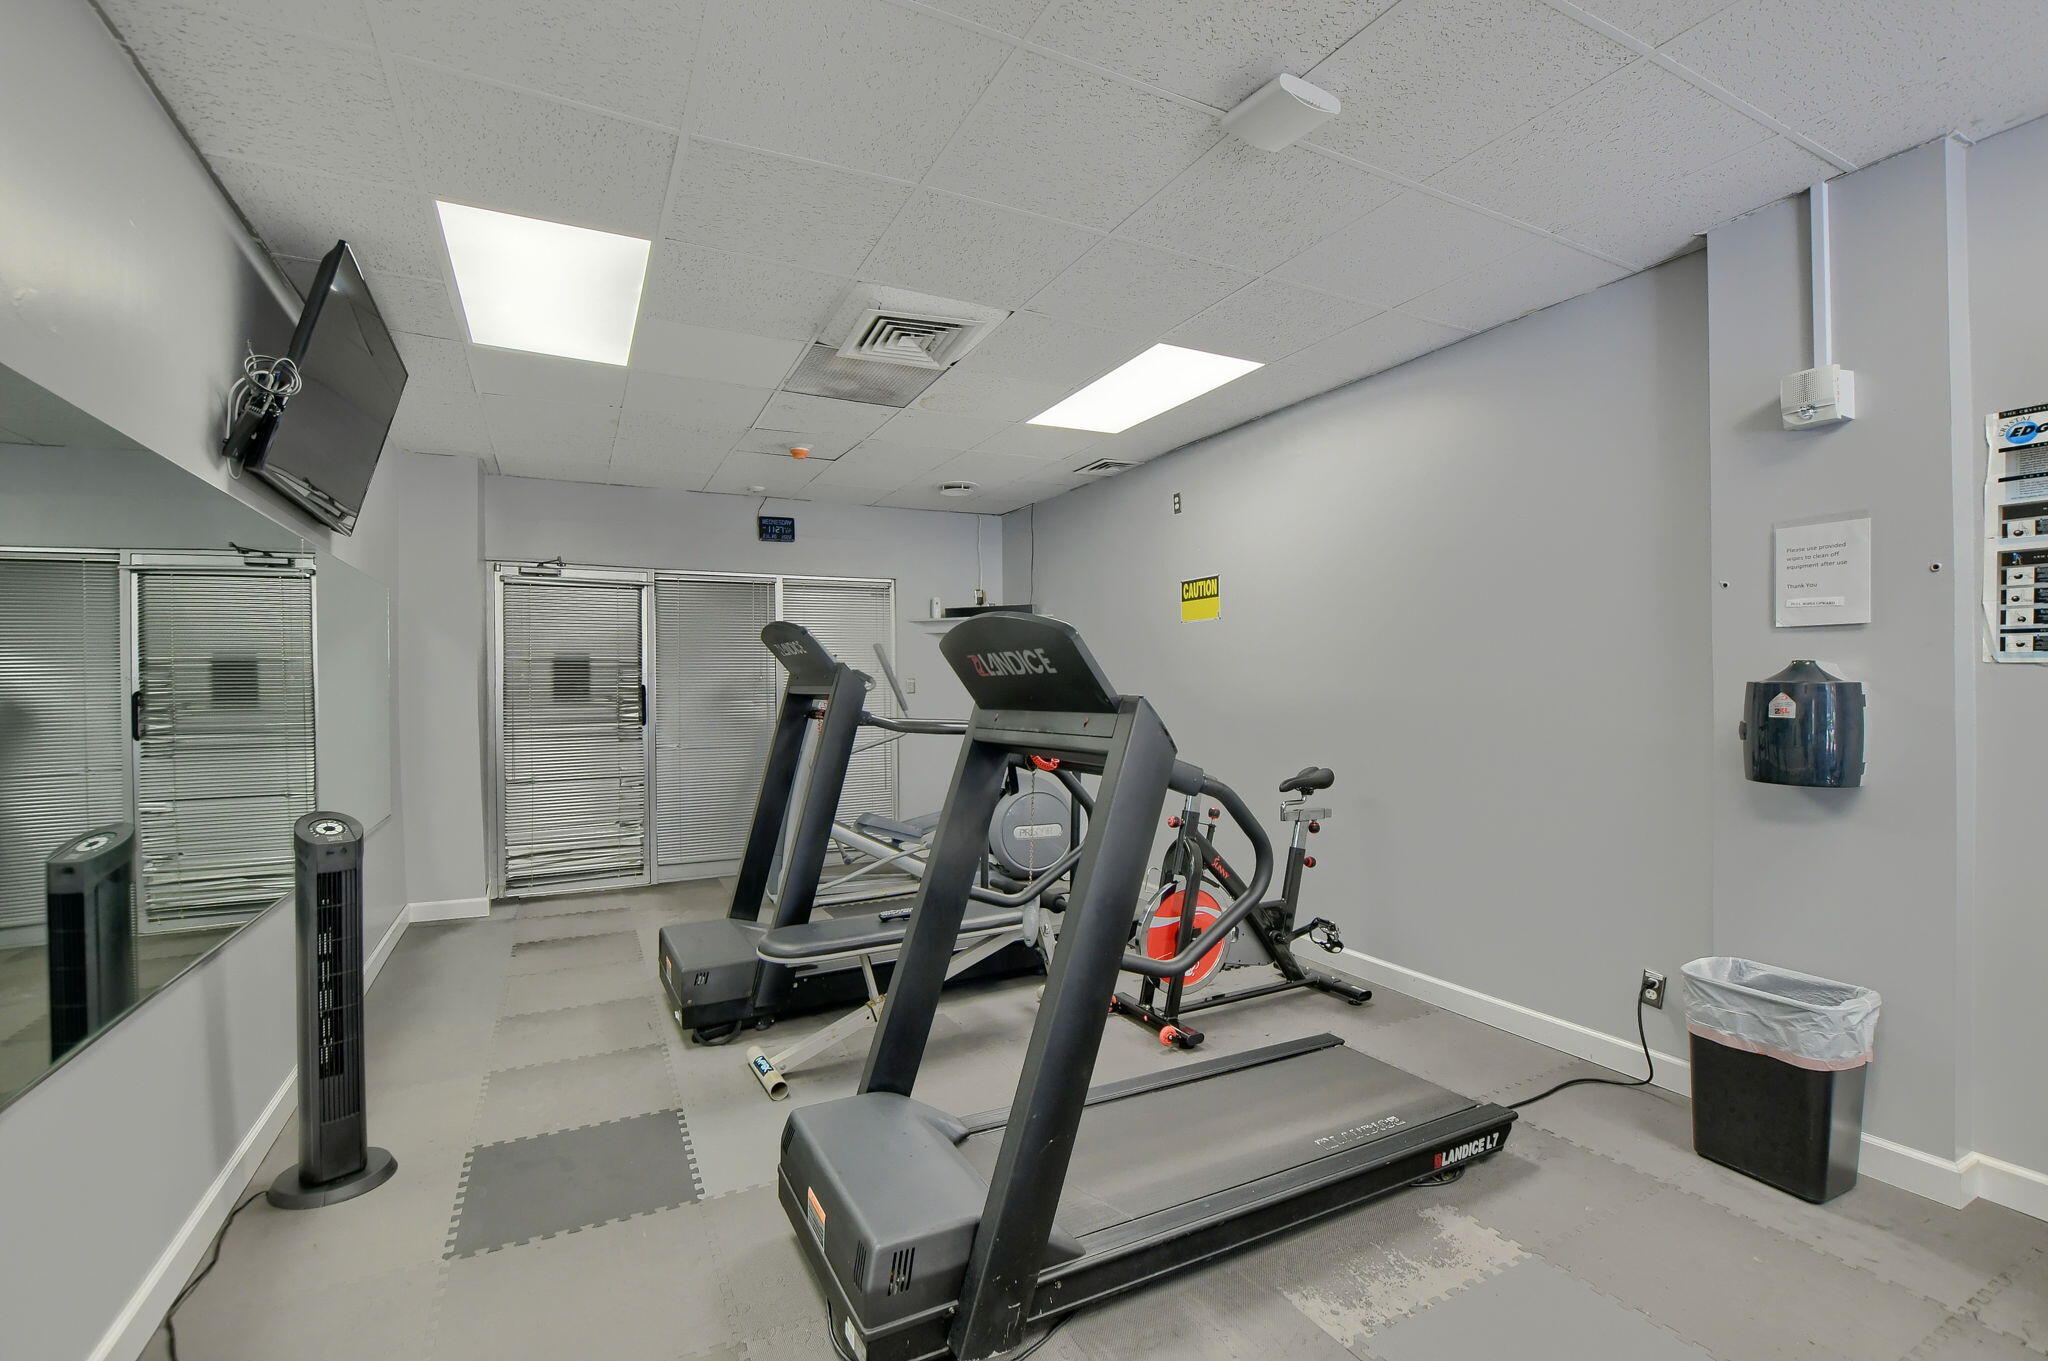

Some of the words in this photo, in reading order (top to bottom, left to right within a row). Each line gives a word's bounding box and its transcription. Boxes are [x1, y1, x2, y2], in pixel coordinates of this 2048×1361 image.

[1818, 542, 1847, 550] provided
[1786, 562, 1819, 570] equipment
[1183, 578, 1218, 599] CAUTION
[977, 647, 1058, 677] LANDICE
[1441, 1137, 1485, 1167] LANDICE
